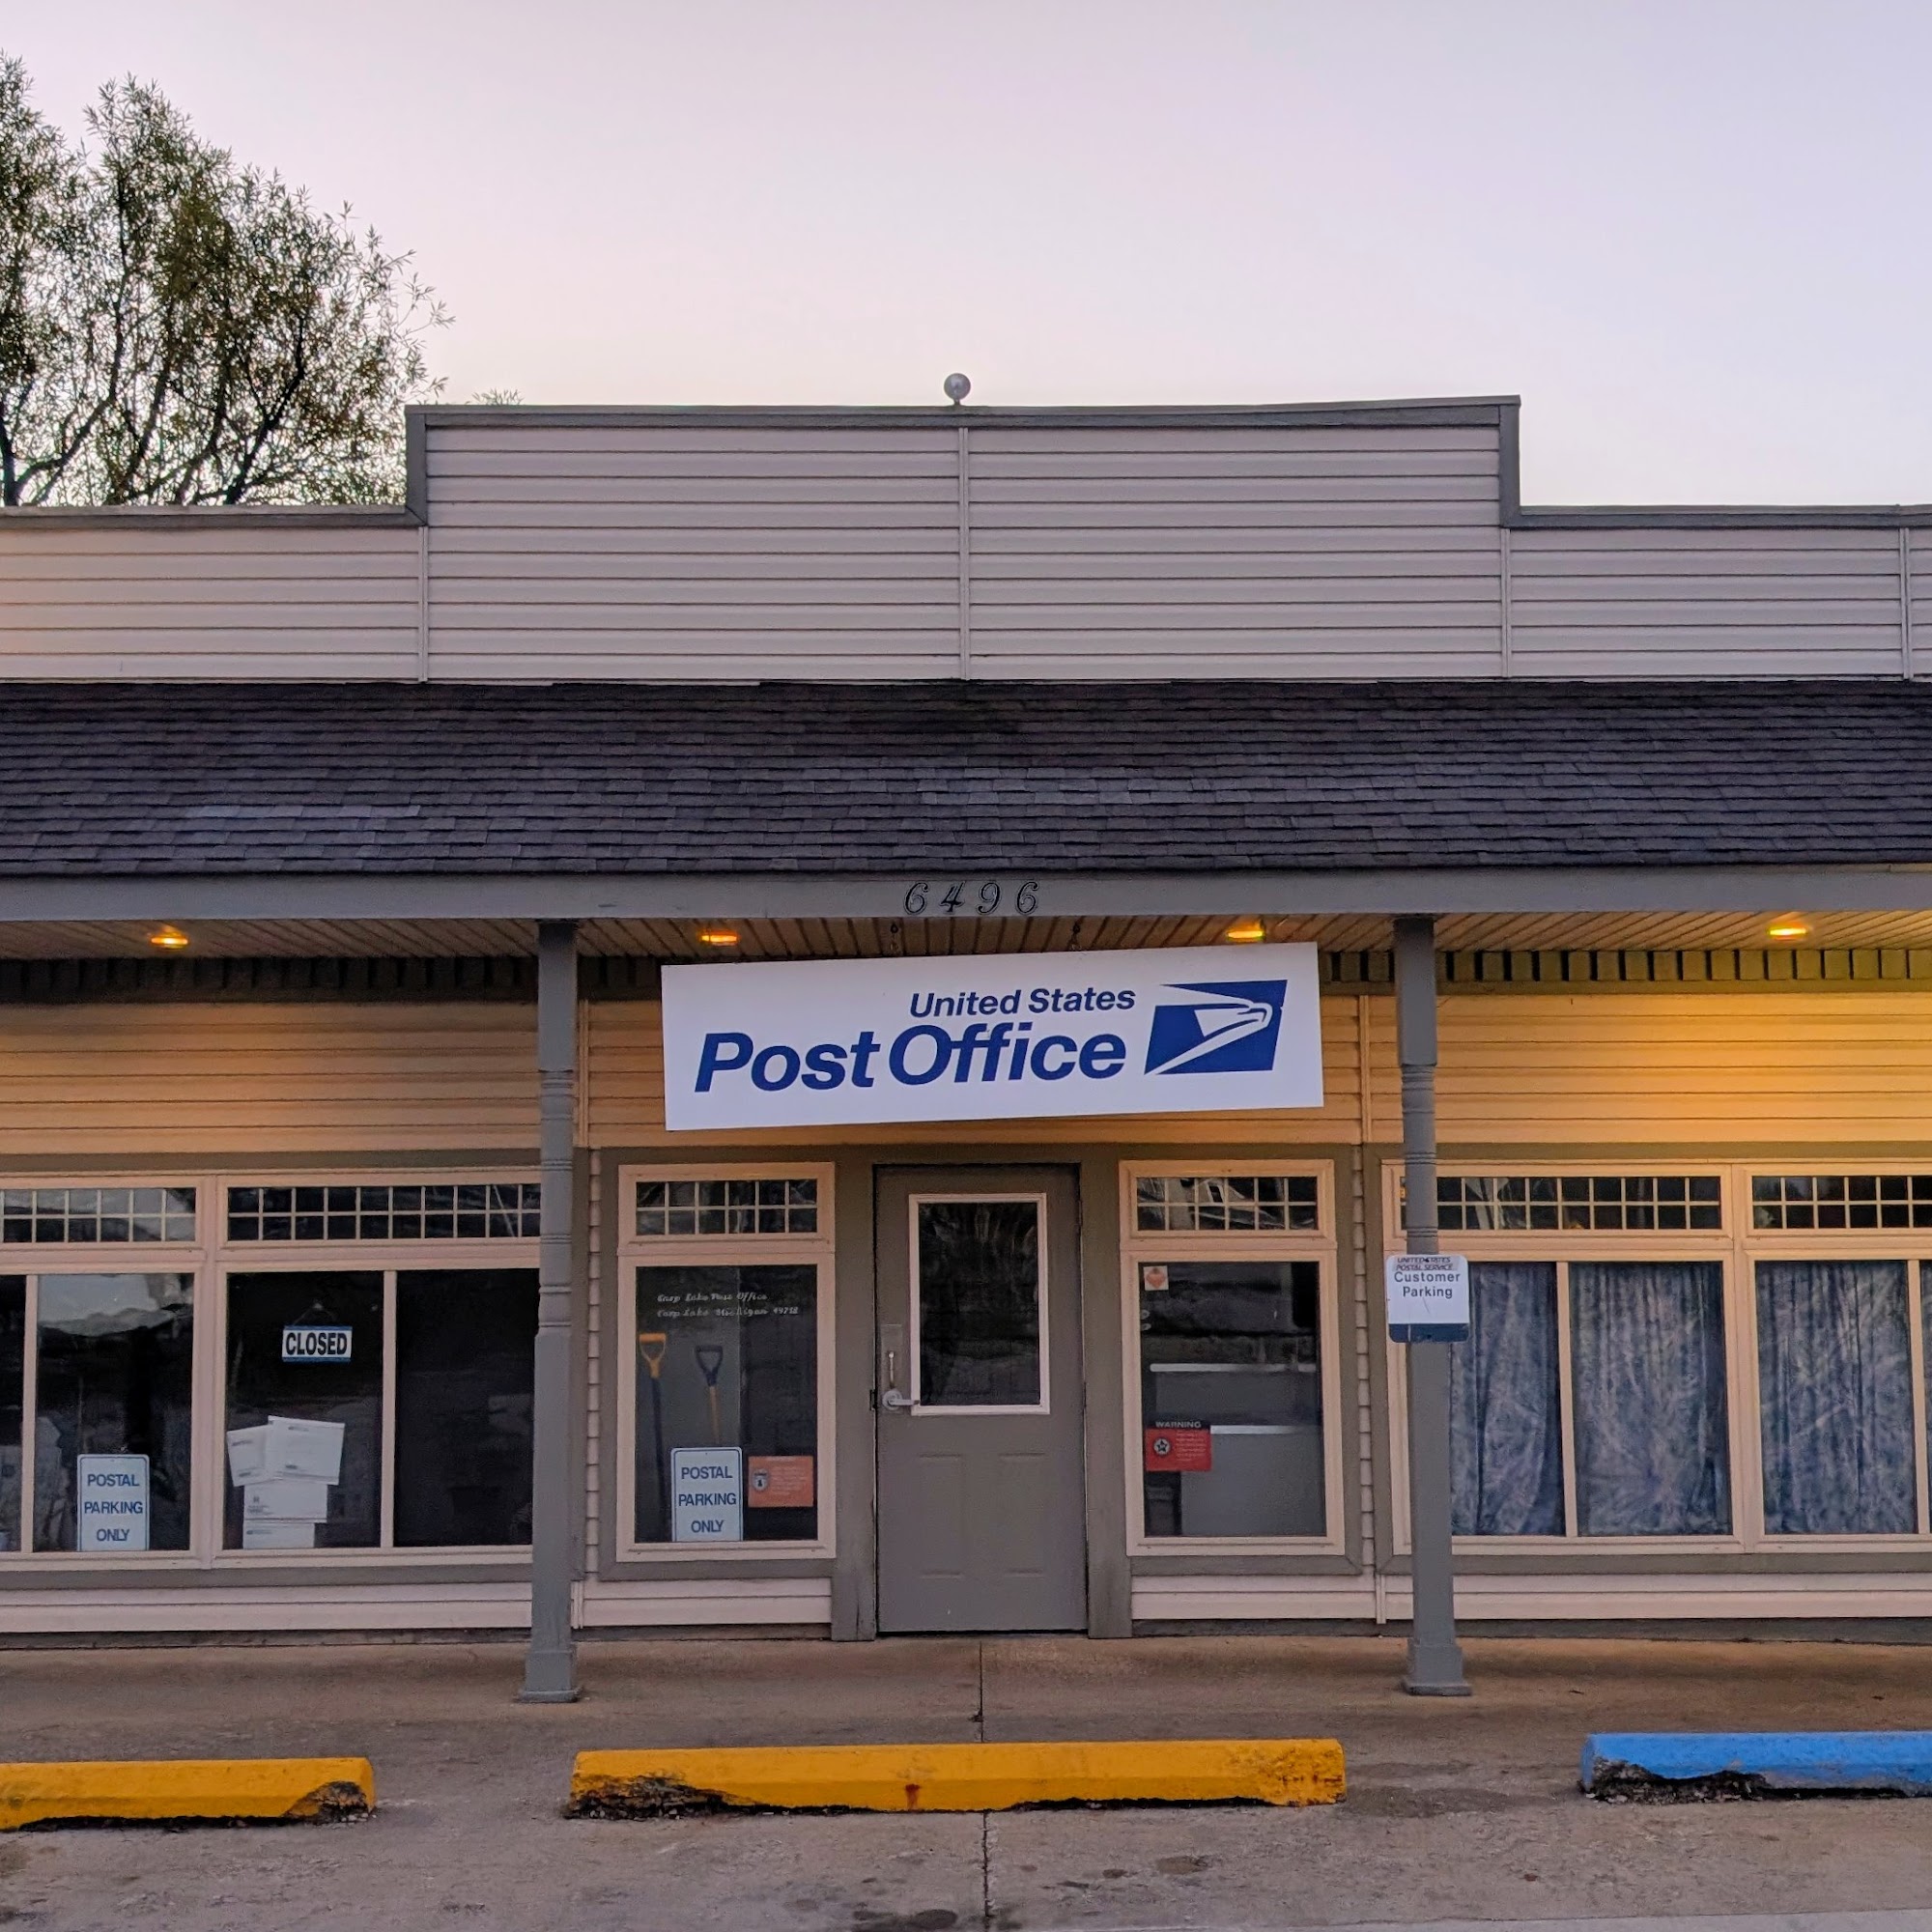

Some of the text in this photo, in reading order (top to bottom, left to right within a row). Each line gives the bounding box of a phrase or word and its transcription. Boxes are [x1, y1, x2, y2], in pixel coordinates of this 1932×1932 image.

[904, 880, 1039, 915] 6496
[910, 987, 1136, 1018] United States
[694, 1020, 1126, 1094] Post Office
[1394, 1271, 1461, 1283] Customer
[1403, 1286, 1453, 1299] Parking
[286, 1332, 348, 1355] CLOSED
[681, 1466, 732, 1479] POSTAL
[87, 1474, 140, 1487] POSTAL
[678, 1492, 737, 1506] PARKING
[84, 1501, 143, 1514] PARKING
[691, 1520, 724, 1533] ONLY
[97, 1529, 129, 1541] ONLY
